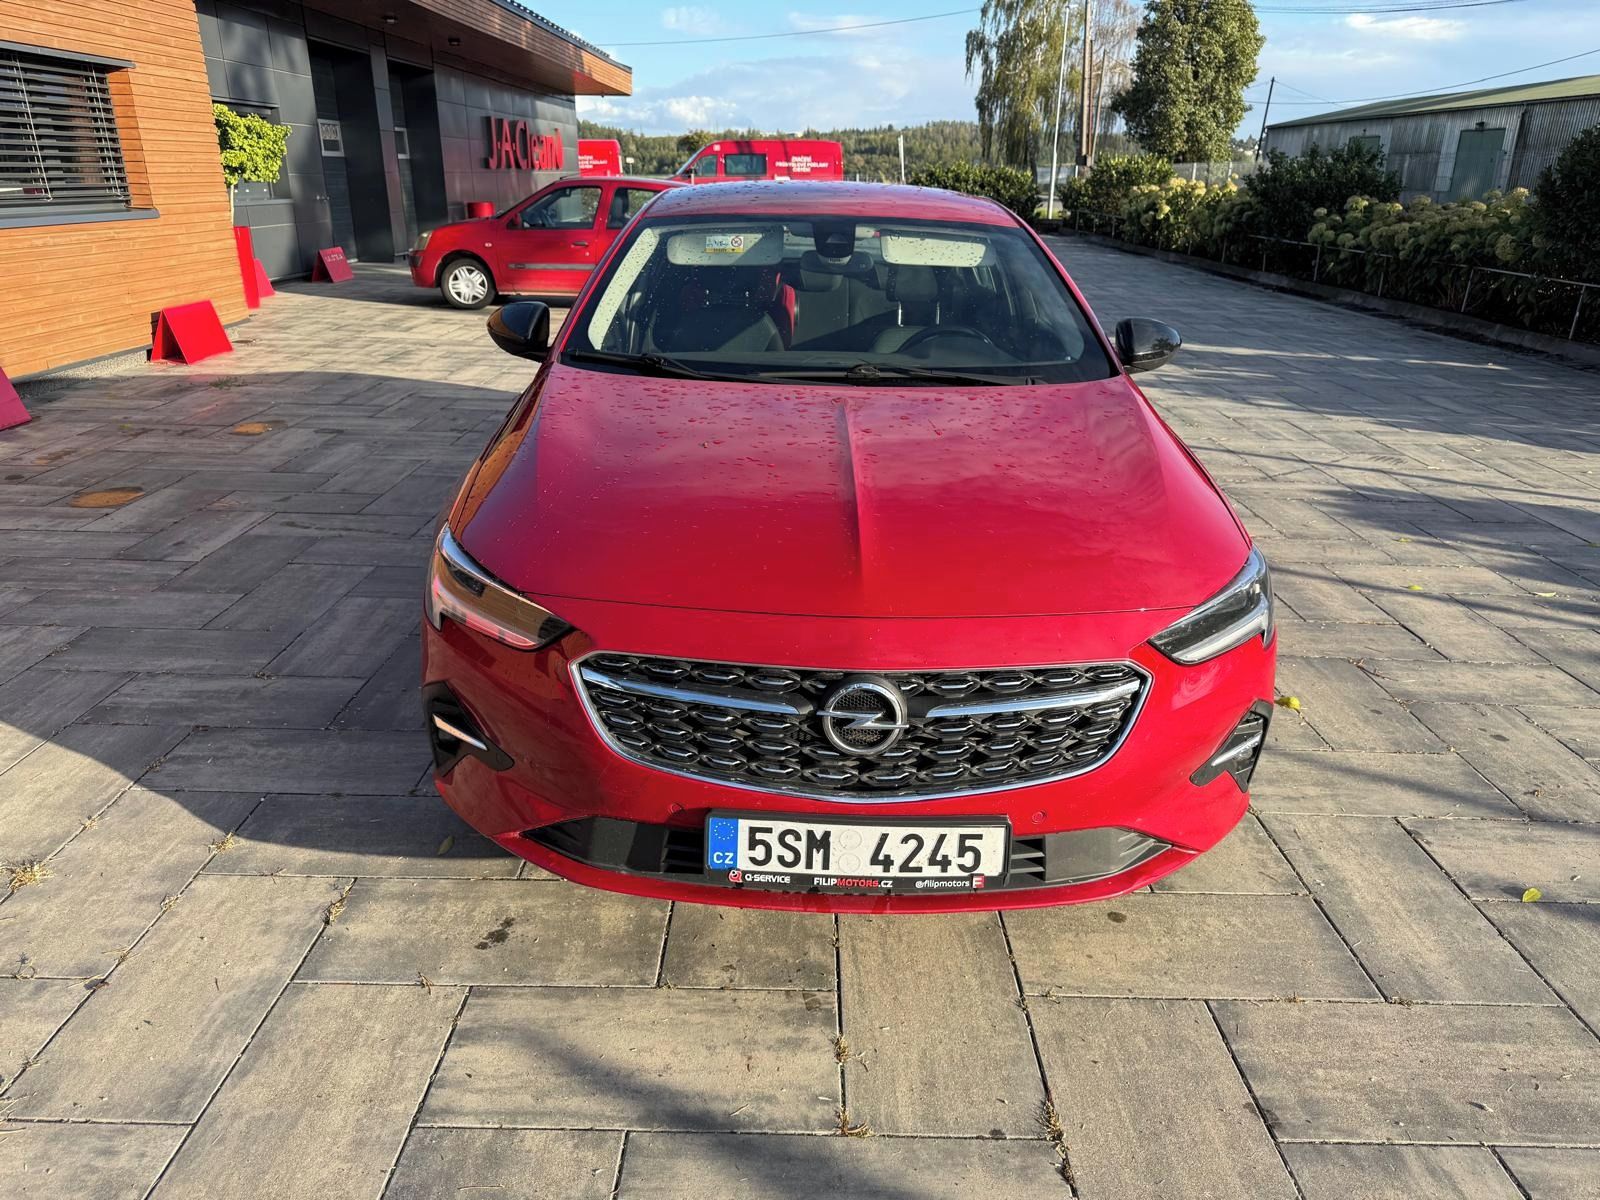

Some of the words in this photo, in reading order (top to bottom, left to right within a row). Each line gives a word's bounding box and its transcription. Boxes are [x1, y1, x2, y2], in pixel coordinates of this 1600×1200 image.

[748, 826, 831, 870] 5SM
[870, 832, 983, 873] 4245
[713, 851, 734, 864] CZ
[813, 877, 893, 888] FILIPMOTORS.CZ
[915, 879, 970, 890] @filipmotors
